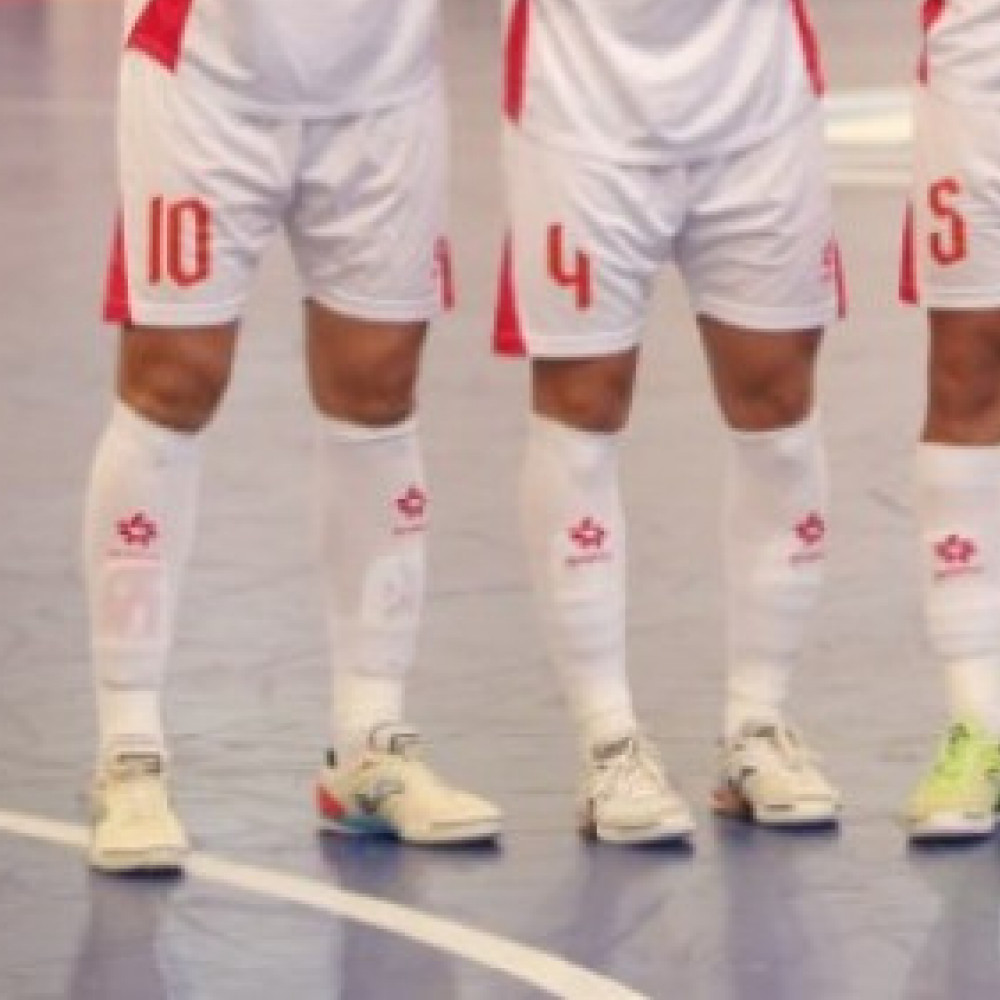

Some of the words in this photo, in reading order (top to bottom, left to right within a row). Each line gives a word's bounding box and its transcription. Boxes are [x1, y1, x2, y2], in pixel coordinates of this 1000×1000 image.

[148, 196, 211, 287] 10
[929, 178, 967, 265] 5
[547, 223, 592, 309] 4
